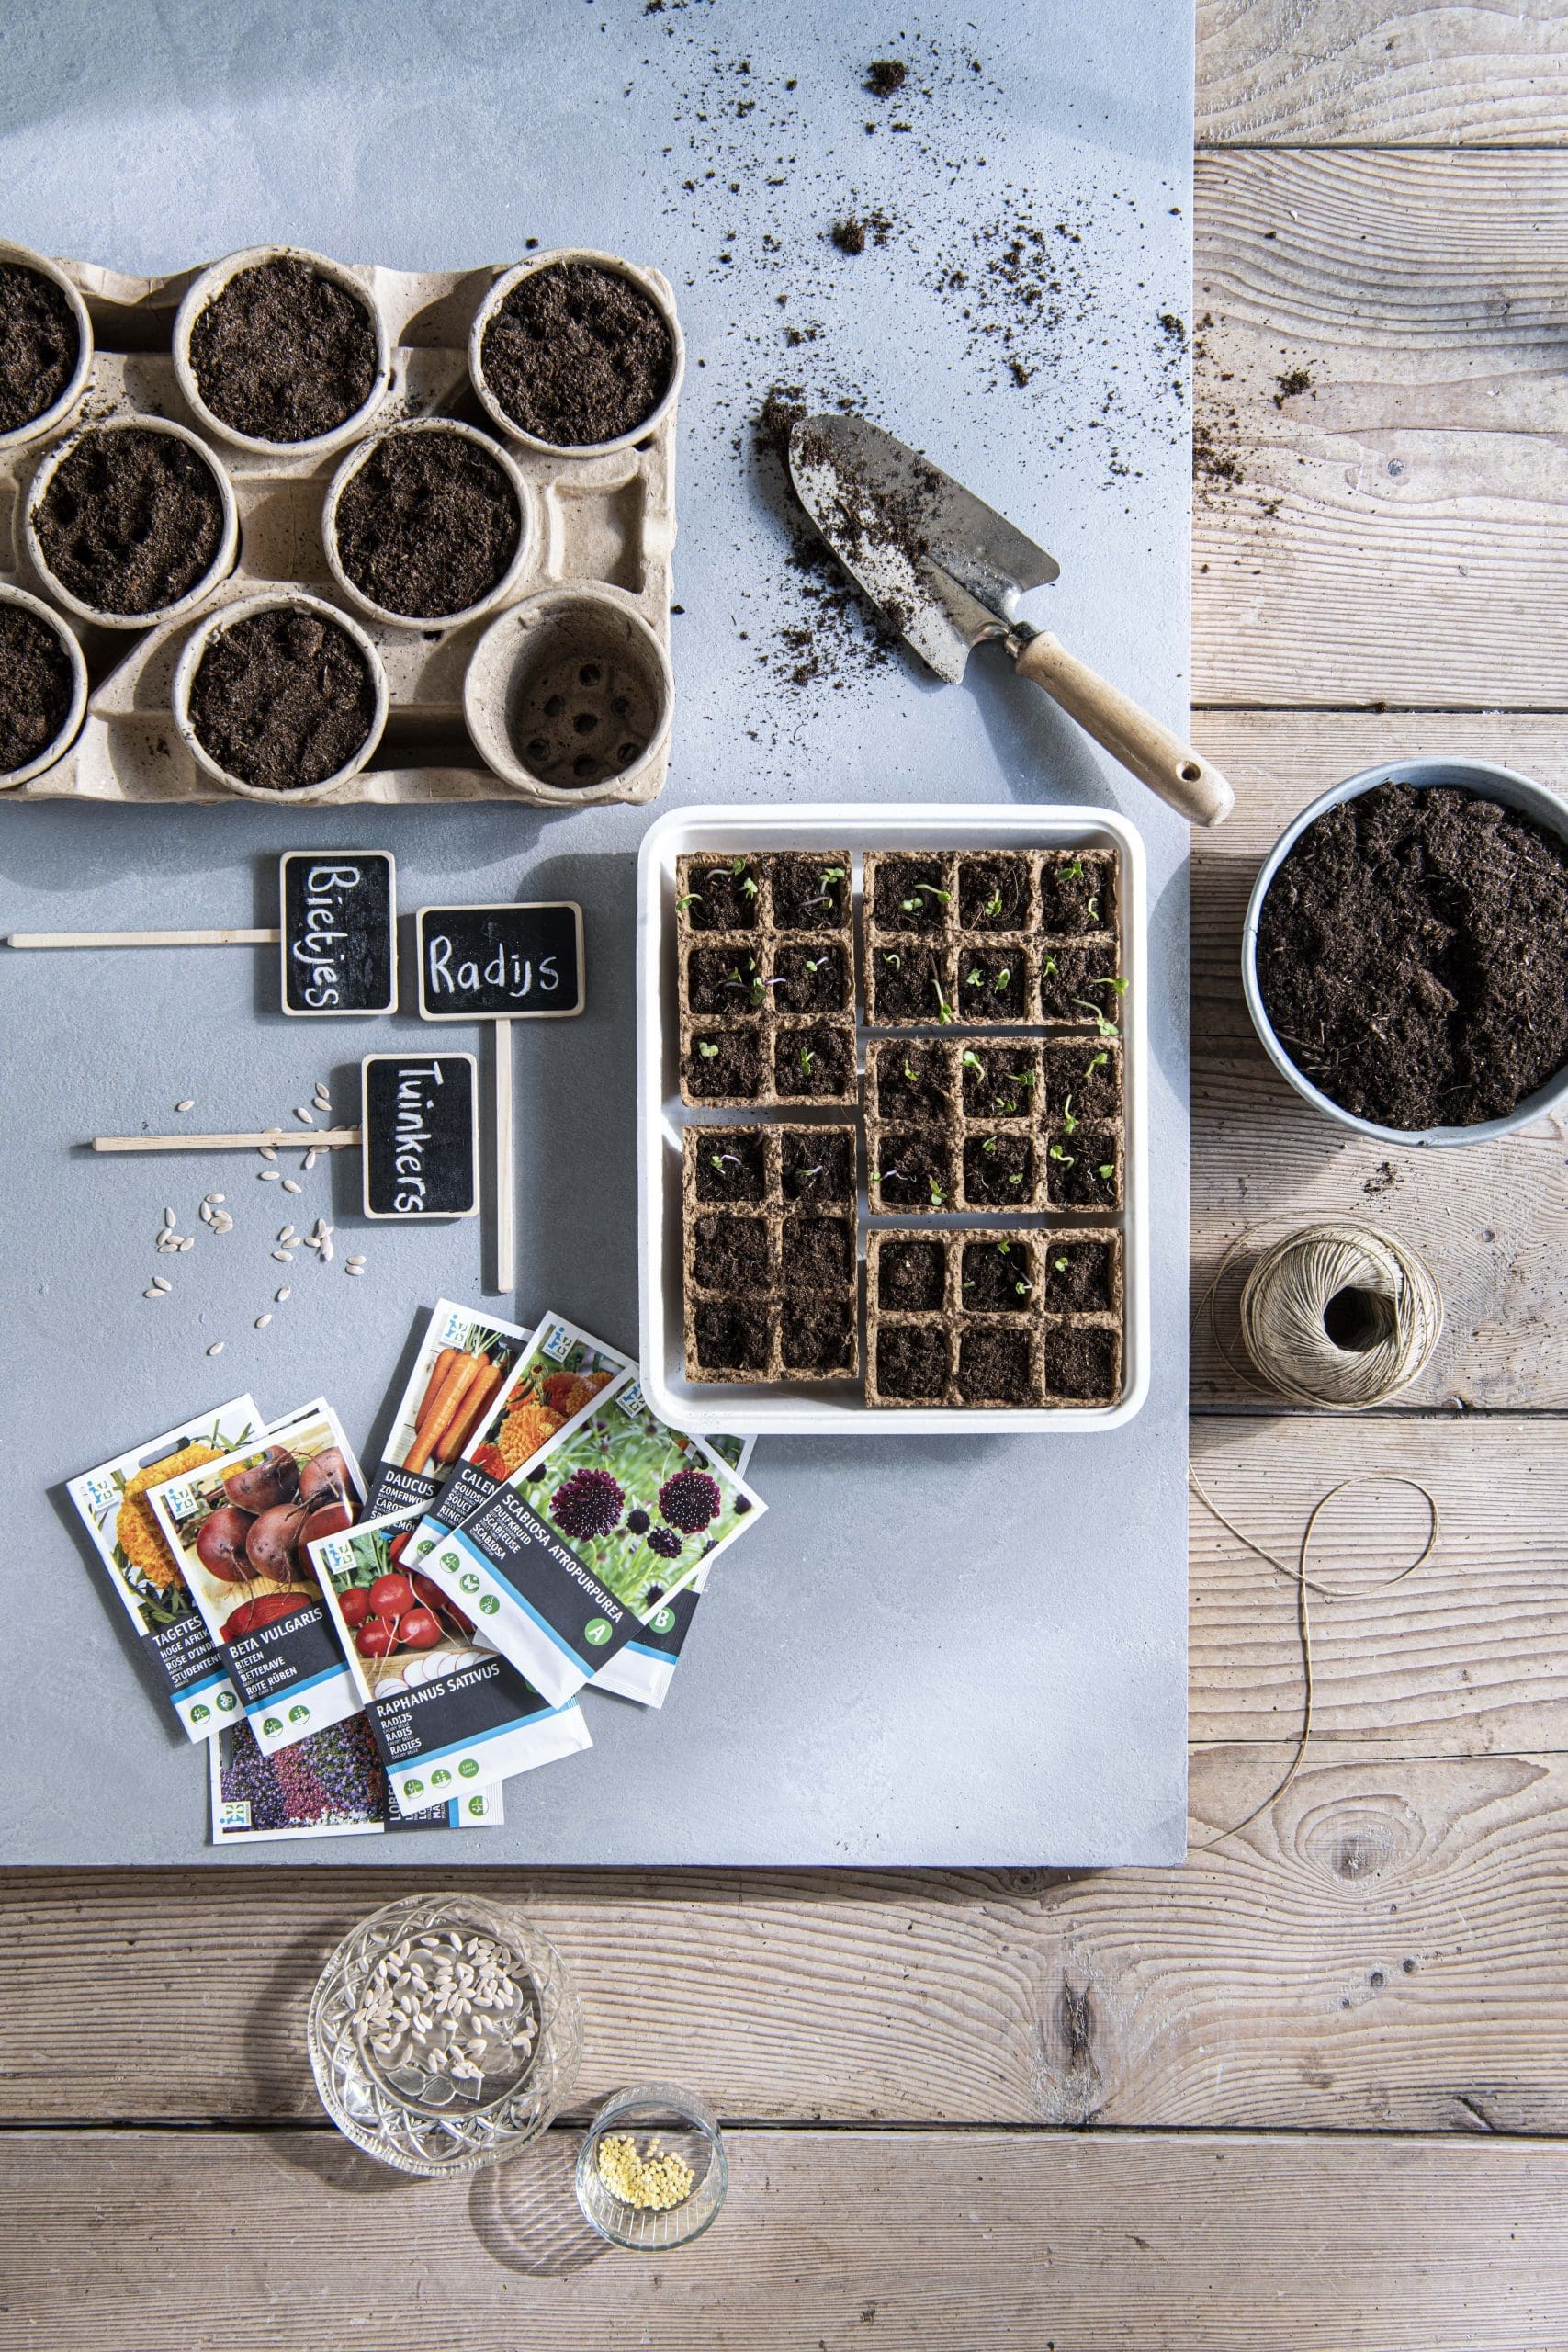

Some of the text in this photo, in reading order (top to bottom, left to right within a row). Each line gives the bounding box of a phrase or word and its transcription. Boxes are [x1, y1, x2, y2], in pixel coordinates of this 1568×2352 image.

[293, 866, 361, 1007] Bietjes
[429, 935, 559, 997] Radijs
[394, 1061, 444, 1213] Tuinkers
[379, 1485, 425, 1505] ZOMERWO
[385, 1470, 435, 1497] DAUCUS
[446, 1492, 472, 1512] SOUCI
[481, 1512, 521, 1554] SCABIEUSE
[492, 1504, 532, 1545] DUIFKRUID
[471, 1522, 507, 1560] SCABIOSA
[501, 1492, 624, 1623] SCABIOSA ATROPURPUREA
[152, 1614, 203, 1647] TAGETES
[654, 1609, 669, 1627] B
[228, 1608, 323, 1658] BETA VULGARIS
[588, 1623, 606, 1642] A
[159, 1641, 183, 1658] HOGE
[165, 1654, 187, 1670] ROSE
[233, 1651, 264, 1670] BIETEN
[239, 1656, 285, 1682] BETTERAVE
[245, 1679, 266, 1695] ROTE
[265, 1664, 298, 1685] RÜBEN
[376, 1663, 500, 1718] RAPHANUS SATIVUS
[380, 1711, 412, 1729] RADIJS
[385, 1725, 412, 1742] RADIS
[389, 1737, 422, 1756] RADIES
